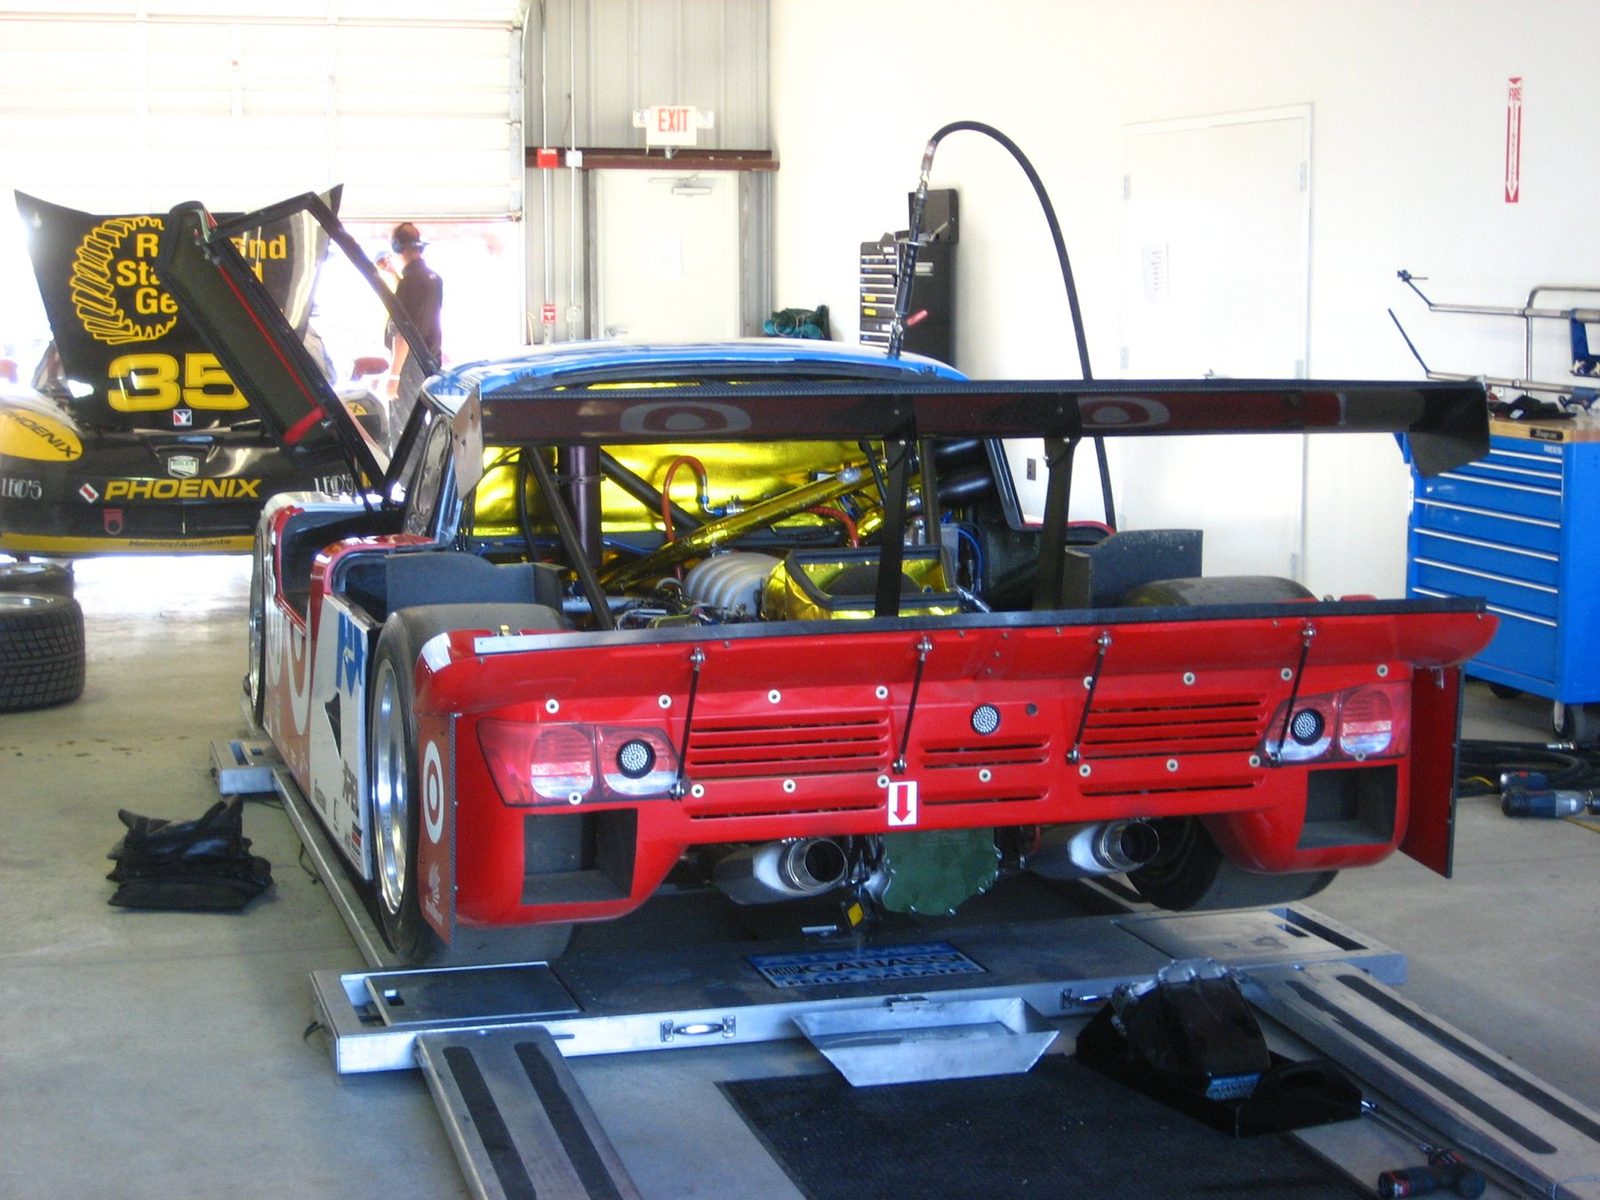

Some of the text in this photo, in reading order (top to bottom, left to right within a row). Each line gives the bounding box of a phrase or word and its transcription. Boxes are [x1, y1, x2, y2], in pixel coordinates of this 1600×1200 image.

[658, 108, 689, 133] EXIT
[108, 353, 250, 412] 35
[104, 479, 263, 500] PHOENIX
